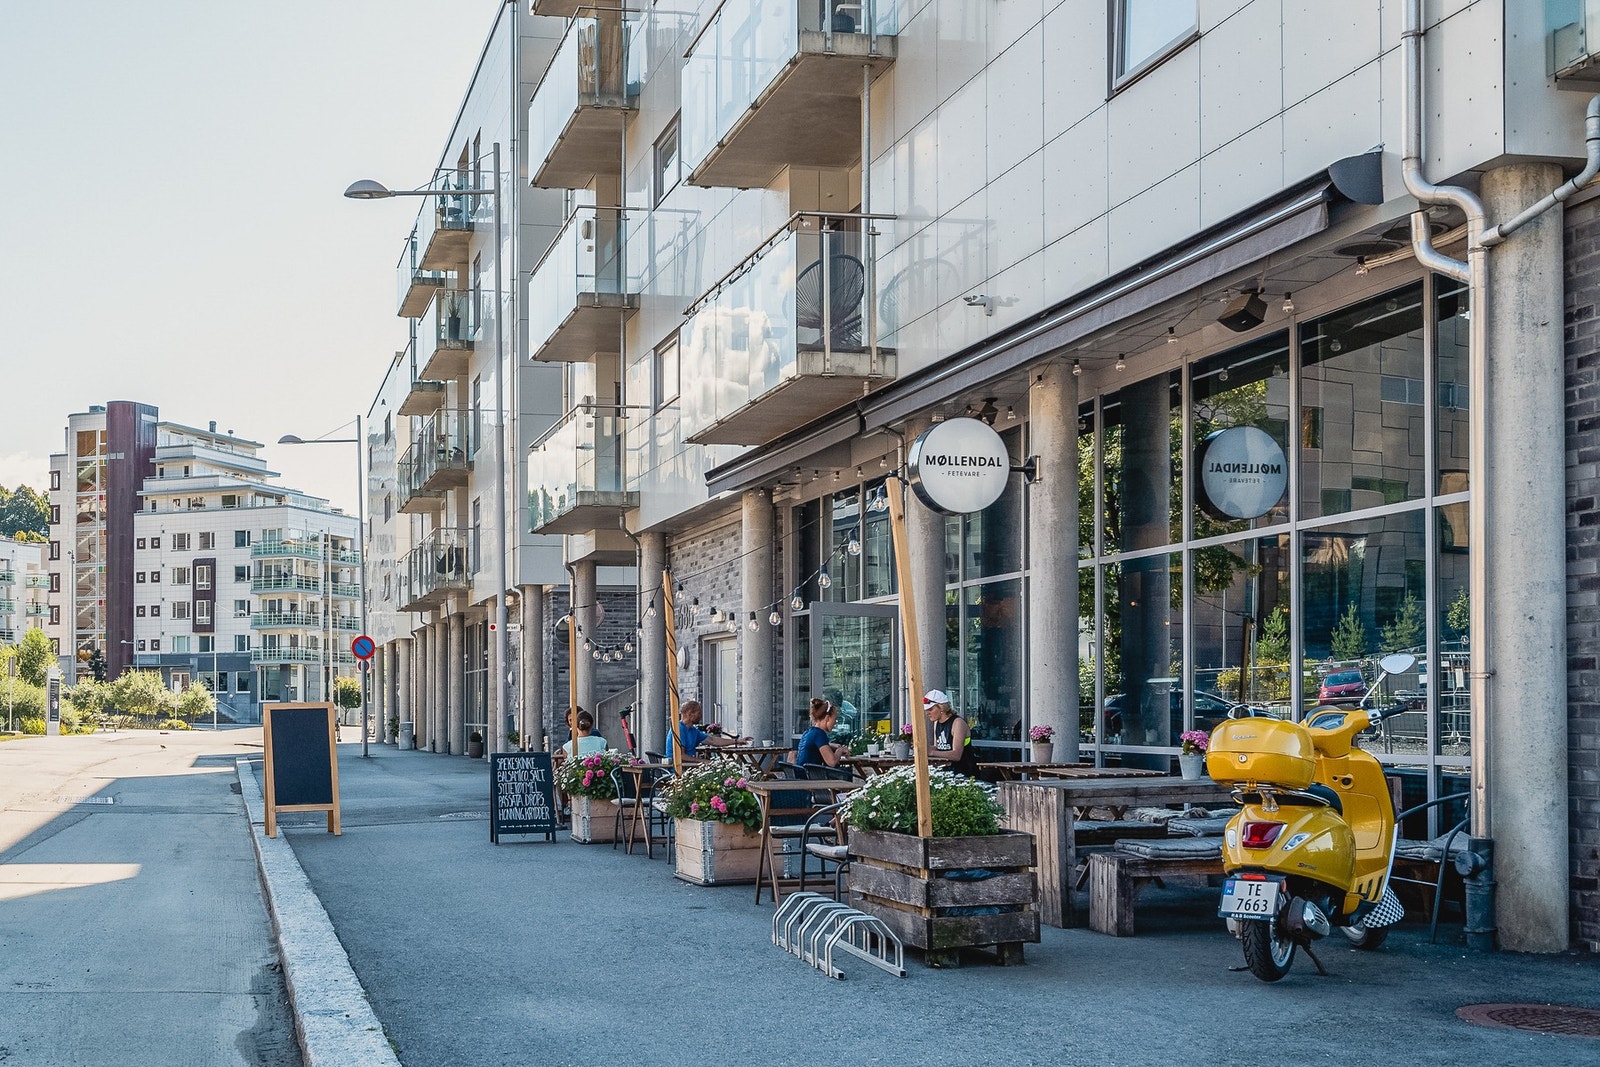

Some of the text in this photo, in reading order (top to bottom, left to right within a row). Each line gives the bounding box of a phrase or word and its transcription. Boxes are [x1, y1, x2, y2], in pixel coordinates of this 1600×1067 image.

[925, 454, 1003, 467] MØLLENDAL
[1248, 883, 1262, 896] TE
[1236, 898, 1268, 912] 7663
